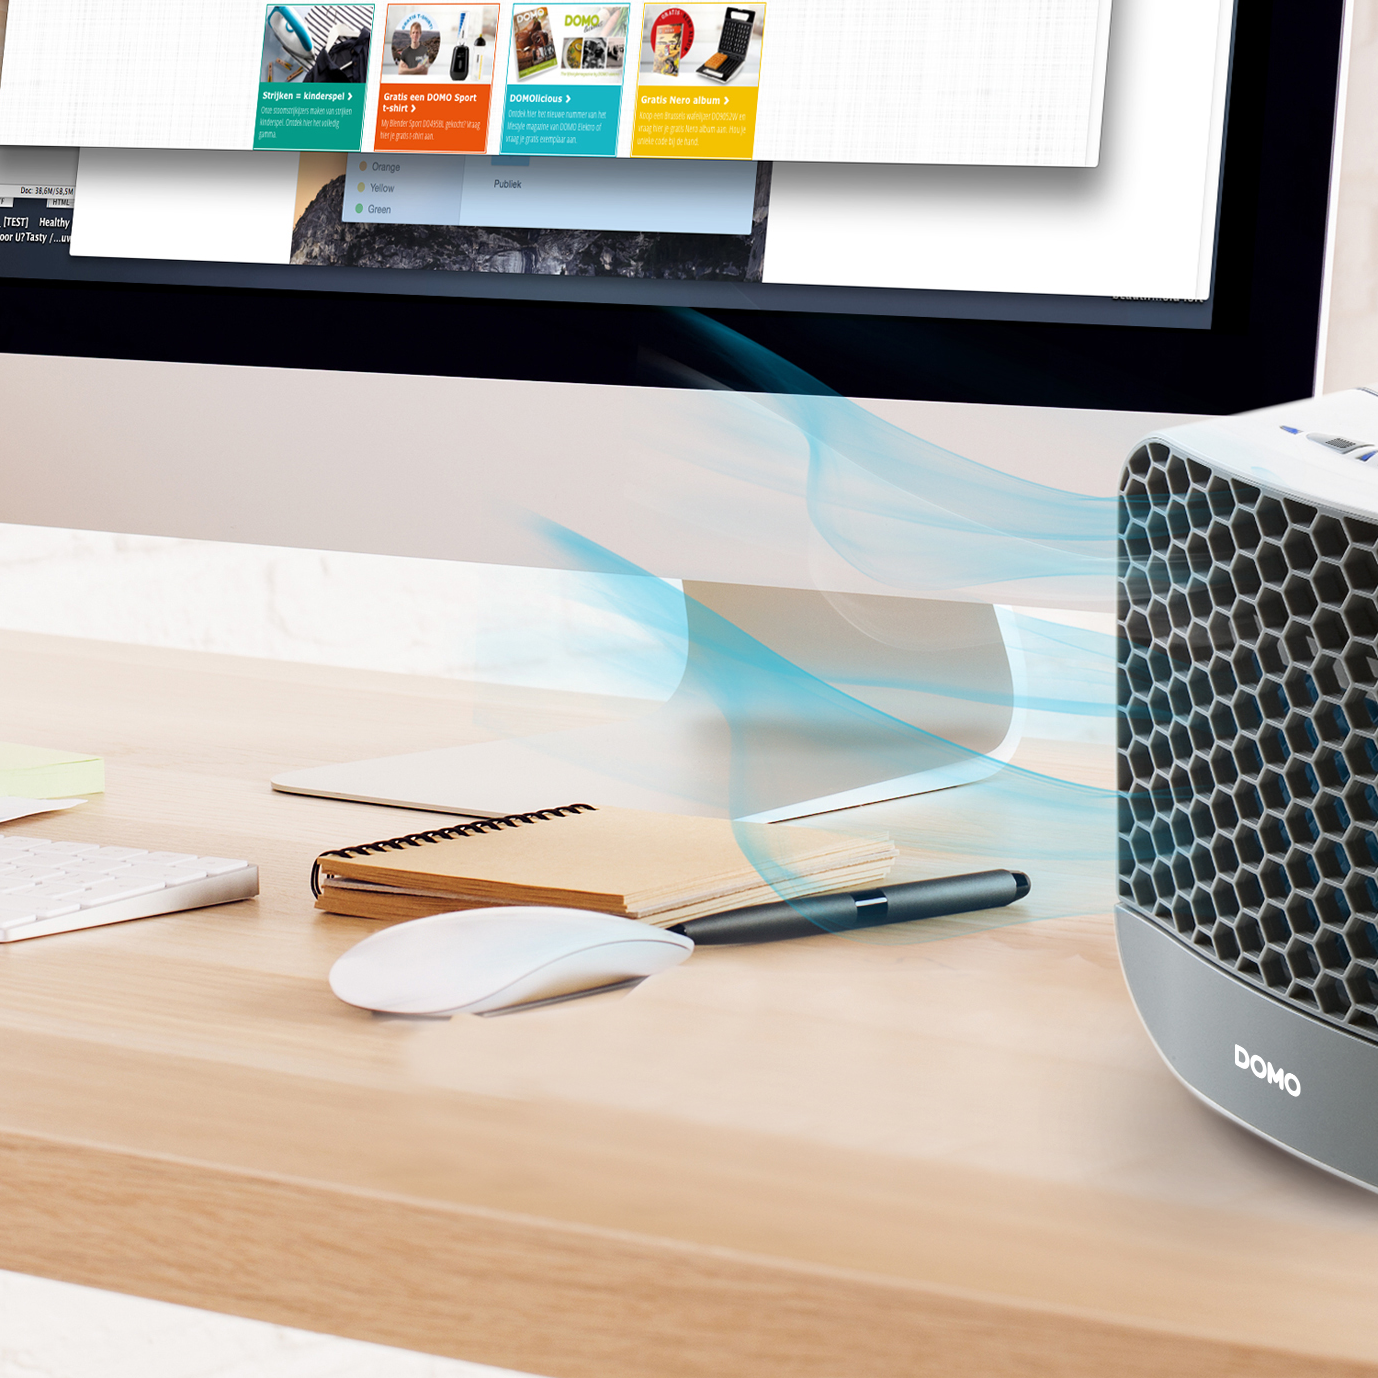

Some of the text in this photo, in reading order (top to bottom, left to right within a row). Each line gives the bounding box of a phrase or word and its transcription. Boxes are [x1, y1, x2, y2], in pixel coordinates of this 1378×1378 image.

[516, 8, 545, 24] DOMO
[564, 14, 600, 27] DOMO
[262, 91, 293, 101] Strijken
[303, 92, 345, 102] kinderspel
[384, 92, 408, 101] Gratis
[427, 93, 452, 102] DOMO
[454, 93, 477, 103] Sport
[509, 94, 562, 103] DOMOlicious
[641, 95, 720, 105] Gratis Nero album
[383, 104, 408, 112] t-shirt
[372, 162, 400, 173] Orange
[370, 183, 395, 193] Yellow
[493, 179, 522, 189] Publiek
[368, 204, 391, 214] Green
[3, 216, 29, 228] [TEST]
[39, 217, 70, 229] Healthy
[15, 233, 25, 242] U?
[26, 232, 47, 243] Tasty
[1234, 1043, 1302, 1098] DOMO
